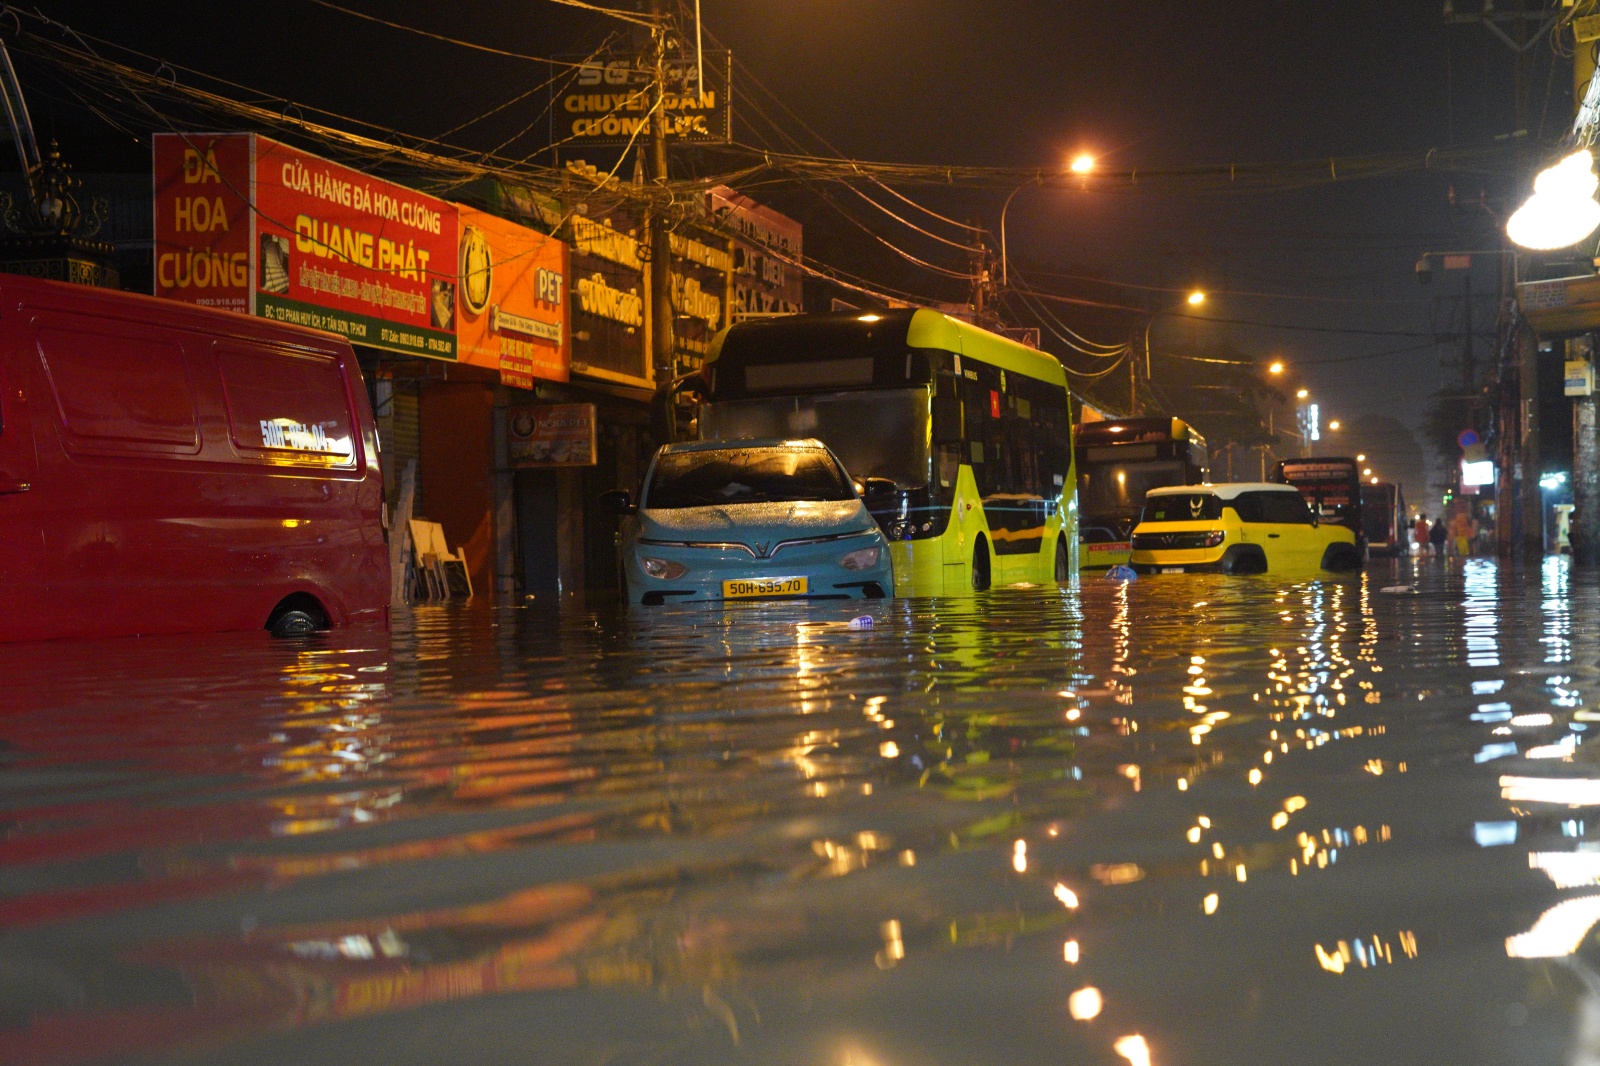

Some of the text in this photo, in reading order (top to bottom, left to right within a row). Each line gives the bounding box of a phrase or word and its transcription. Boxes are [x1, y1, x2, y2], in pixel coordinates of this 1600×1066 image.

[578, 61, 630, 86] SG
[183, 140, 221, 184] ĐÁ
[175, 196, 229, 232] HOA
[281, 158, 441, 235] CỬA HÀNG ĐÁ HOA CƯƠNG
[158, 246, 248, 288] CƯƠNG
[296, 214, 430, 284] QUANG PHÁT
[539, 267, 563, 305] PET
[276, 307, 284, 321] 123
[285, 308, 300, 323] PHAN
[301, 311, 311, 325] HUY
